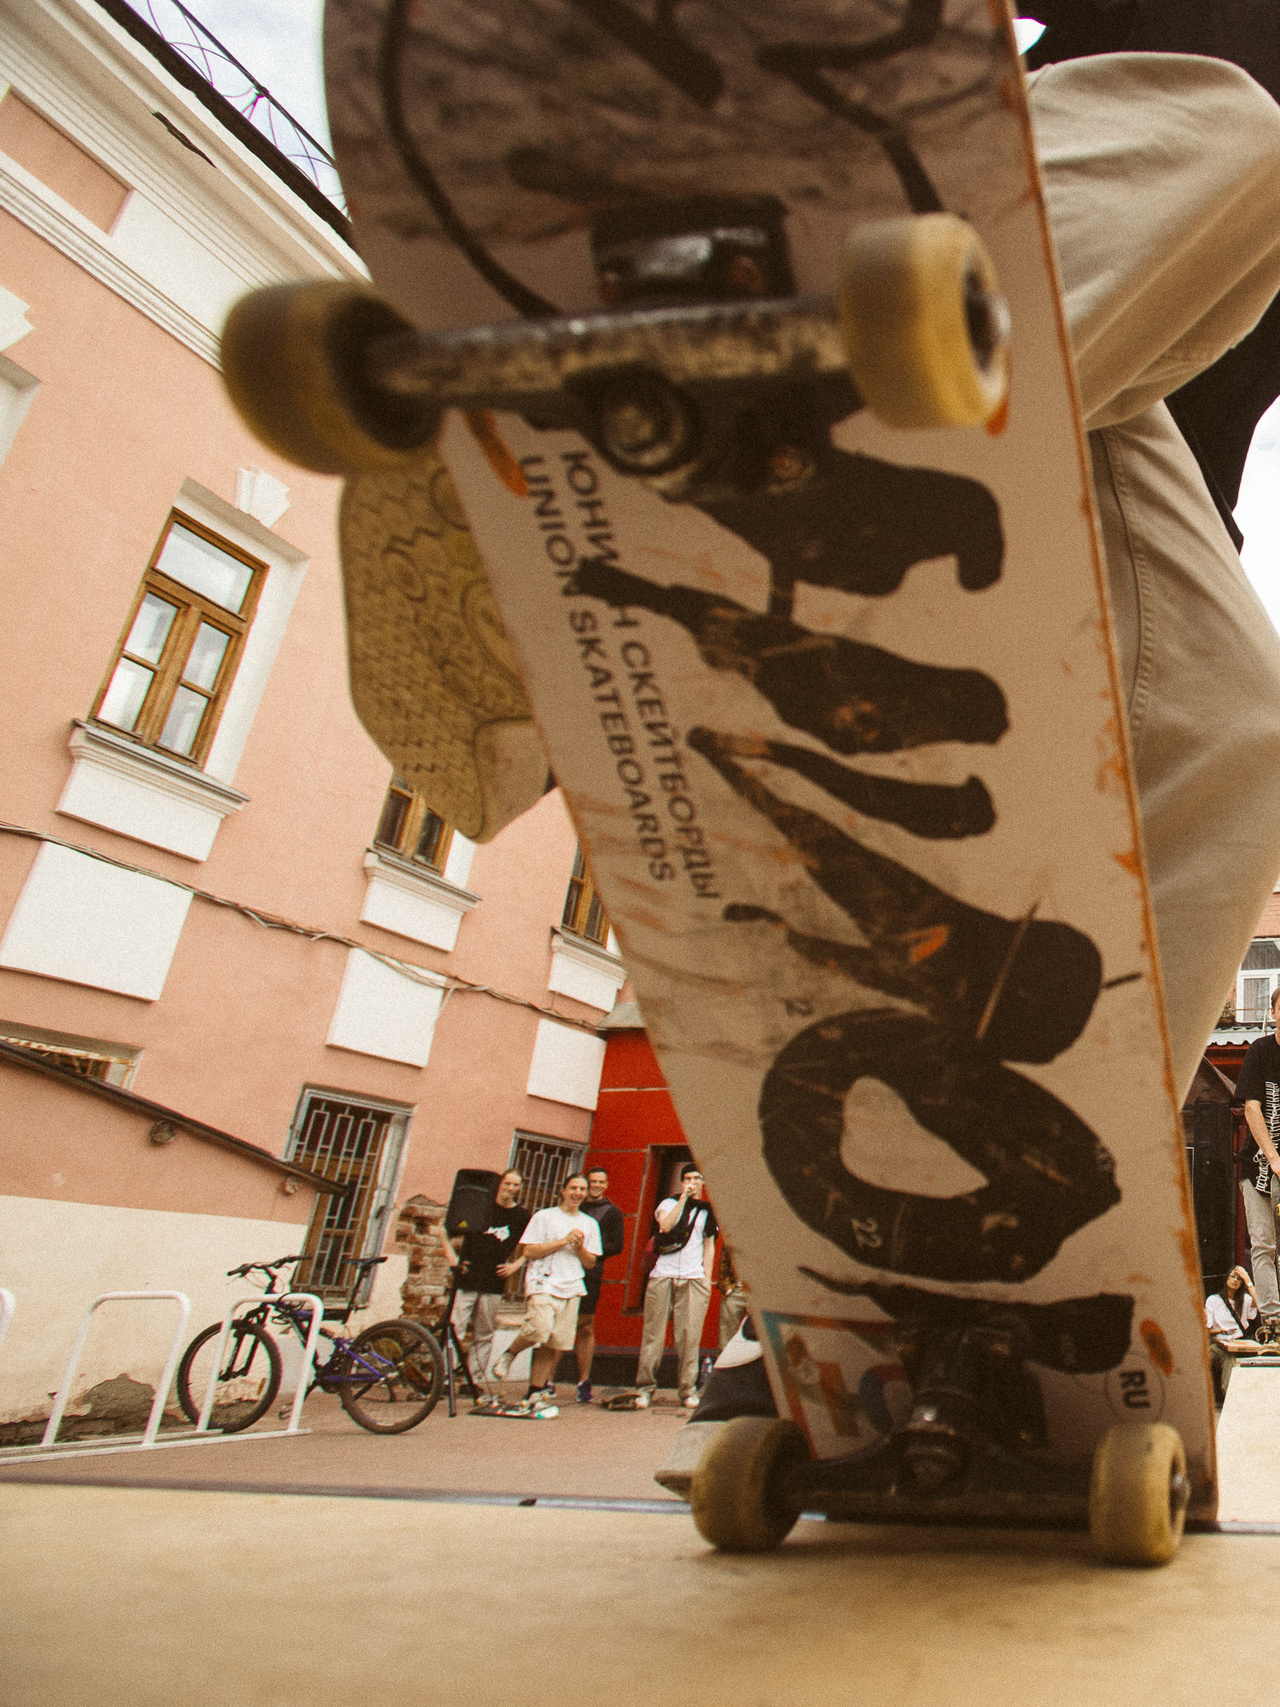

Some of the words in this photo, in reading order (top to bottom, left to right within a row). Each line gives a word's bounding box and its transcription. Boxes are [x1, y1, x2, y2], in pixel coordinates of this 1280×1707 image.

[560, 450, 642, 630] ЮНИН
[620, 640, 721, 900] СКЕЙТБОРДЫ
[569, 608, 675, 882] SKATEBOARDS
[1118, 1369, 1152, 1410] RU
